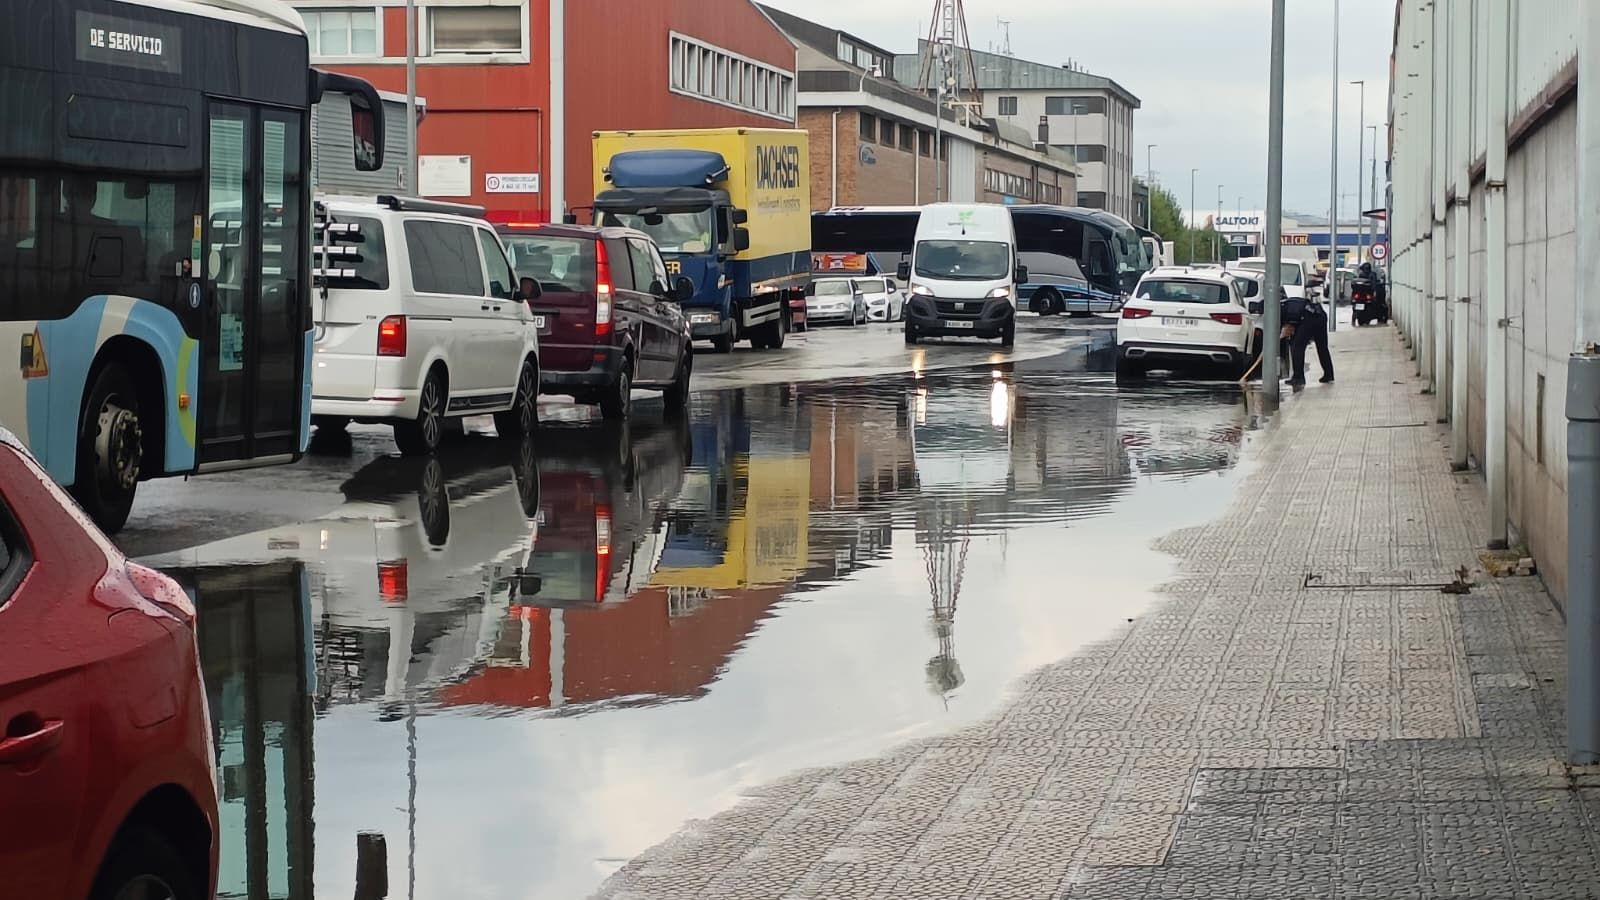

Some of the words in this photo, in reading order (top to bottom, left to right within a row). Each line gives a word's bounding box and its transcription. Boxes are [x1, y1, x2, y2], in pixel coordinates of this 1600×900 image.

[90, 28, 105, 48] DE
[108, 31, 162, 56] SERVICIO
[756, 145, 800, 189] DACHSER
[1215, 217, 1259, 226] SALTOKI
